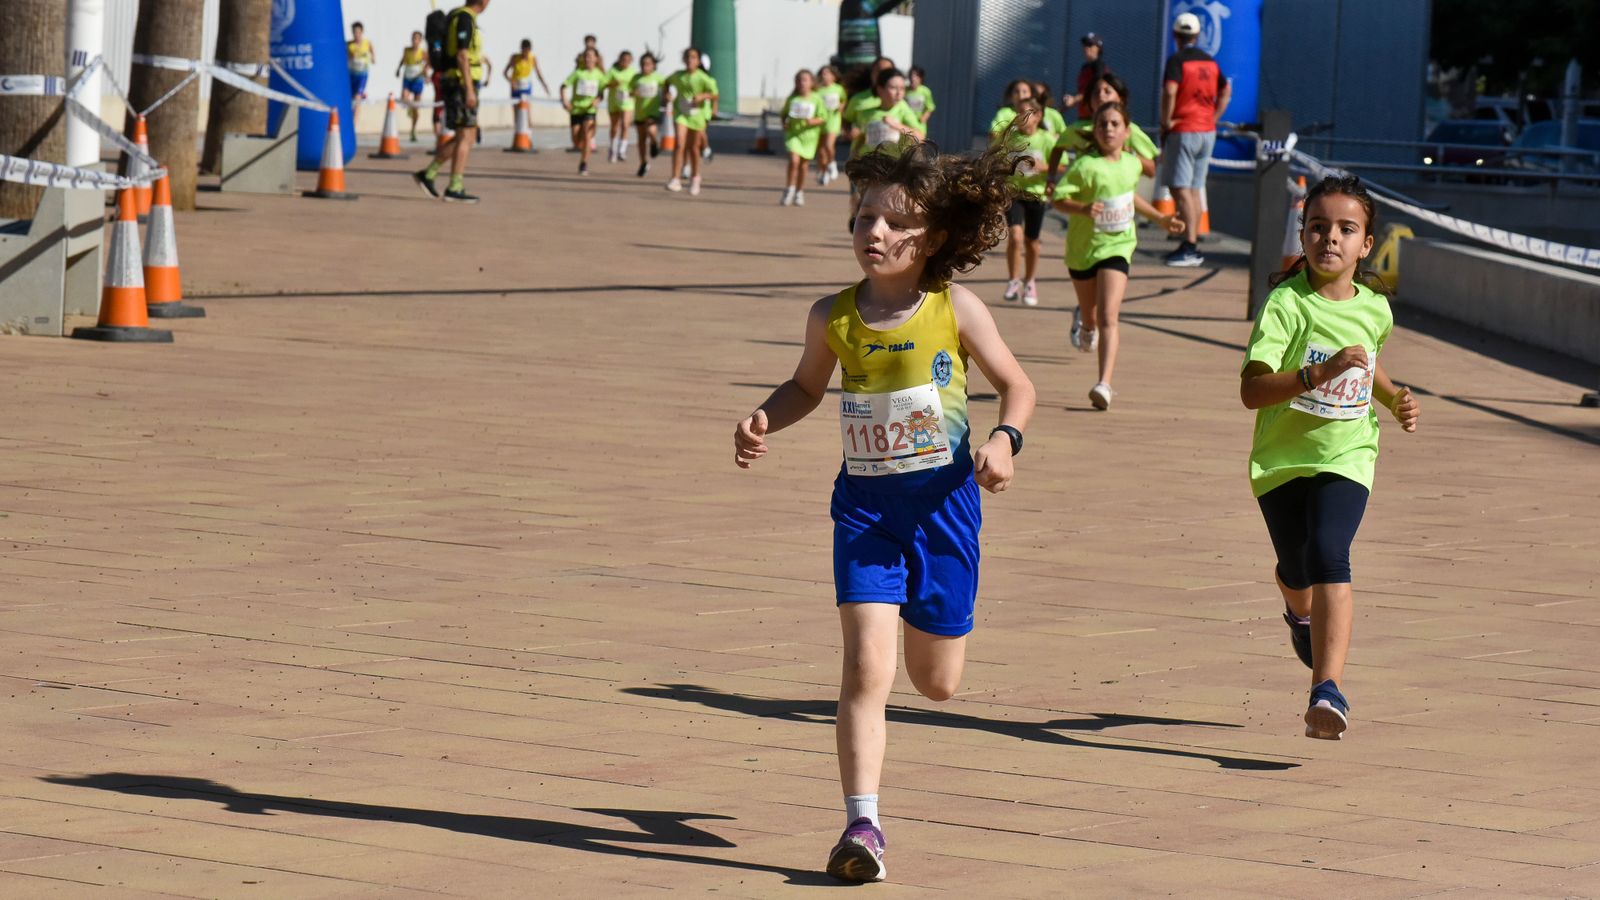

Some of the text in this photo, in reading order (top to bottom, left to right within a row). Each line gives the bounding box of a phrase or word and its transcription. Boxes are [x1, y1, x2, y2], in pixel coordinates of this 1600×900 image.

[1315, 378, 1359, 401] 443
[842, 400, 855, 414] XXI
[892, 395, 913, 404] VEGA
[847, 422, 908, 453] 1182
